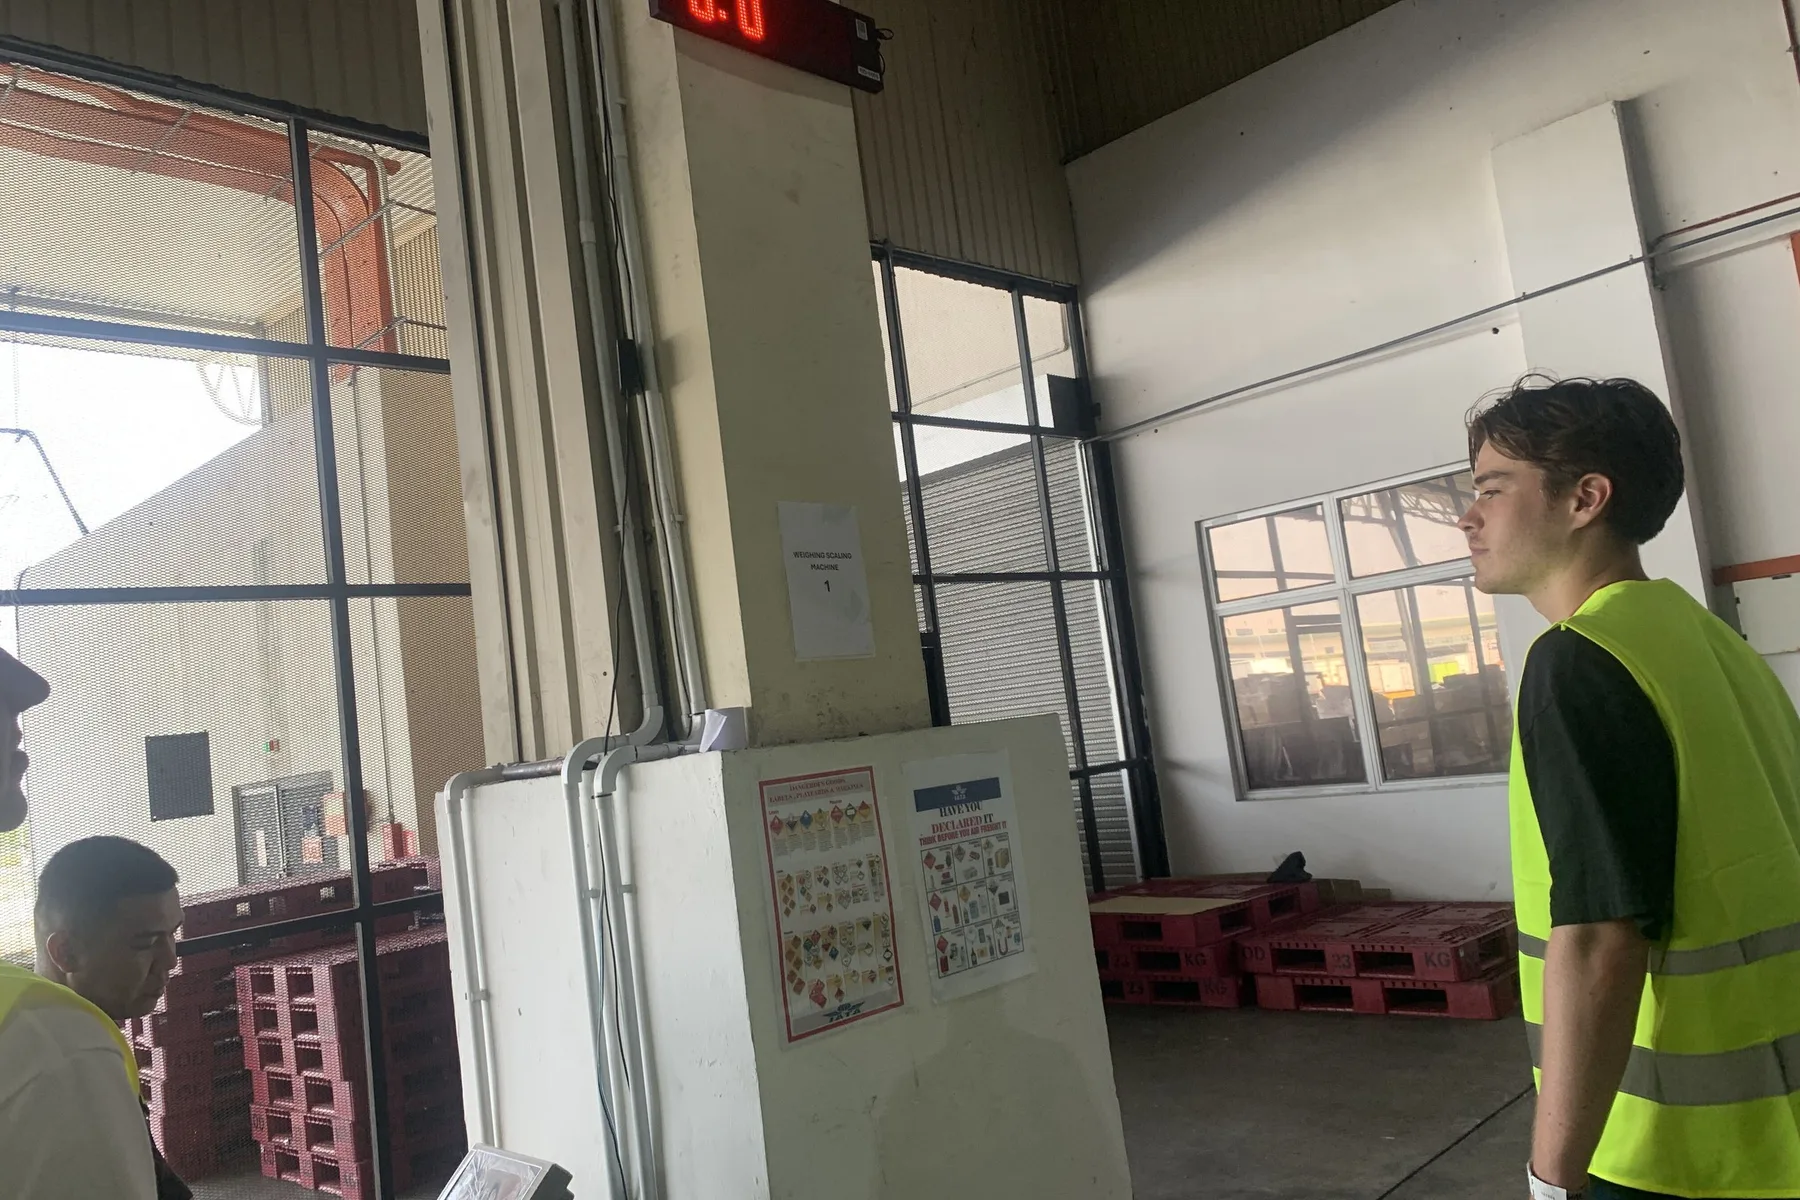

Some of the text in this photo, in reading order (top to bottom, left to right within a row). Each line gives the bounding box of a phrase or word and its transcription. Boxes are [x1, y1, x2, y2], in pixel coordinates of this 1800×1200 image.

[793, 551, 852, 560] WEIGHING SCALING
[824, 579, 831, 592] 1
[940, 801, 982, 817] HAVE YOU
[931, 813, 994, 833] DECLARED IT
[919, 820, 1007, 846] THINK BEFORE YOU AIR FREIGHT IT
[1185, 952, 1207, 966] KG
[1424, 951, 1451, 968] KG
[1204, 979, 1227, 995] KG
